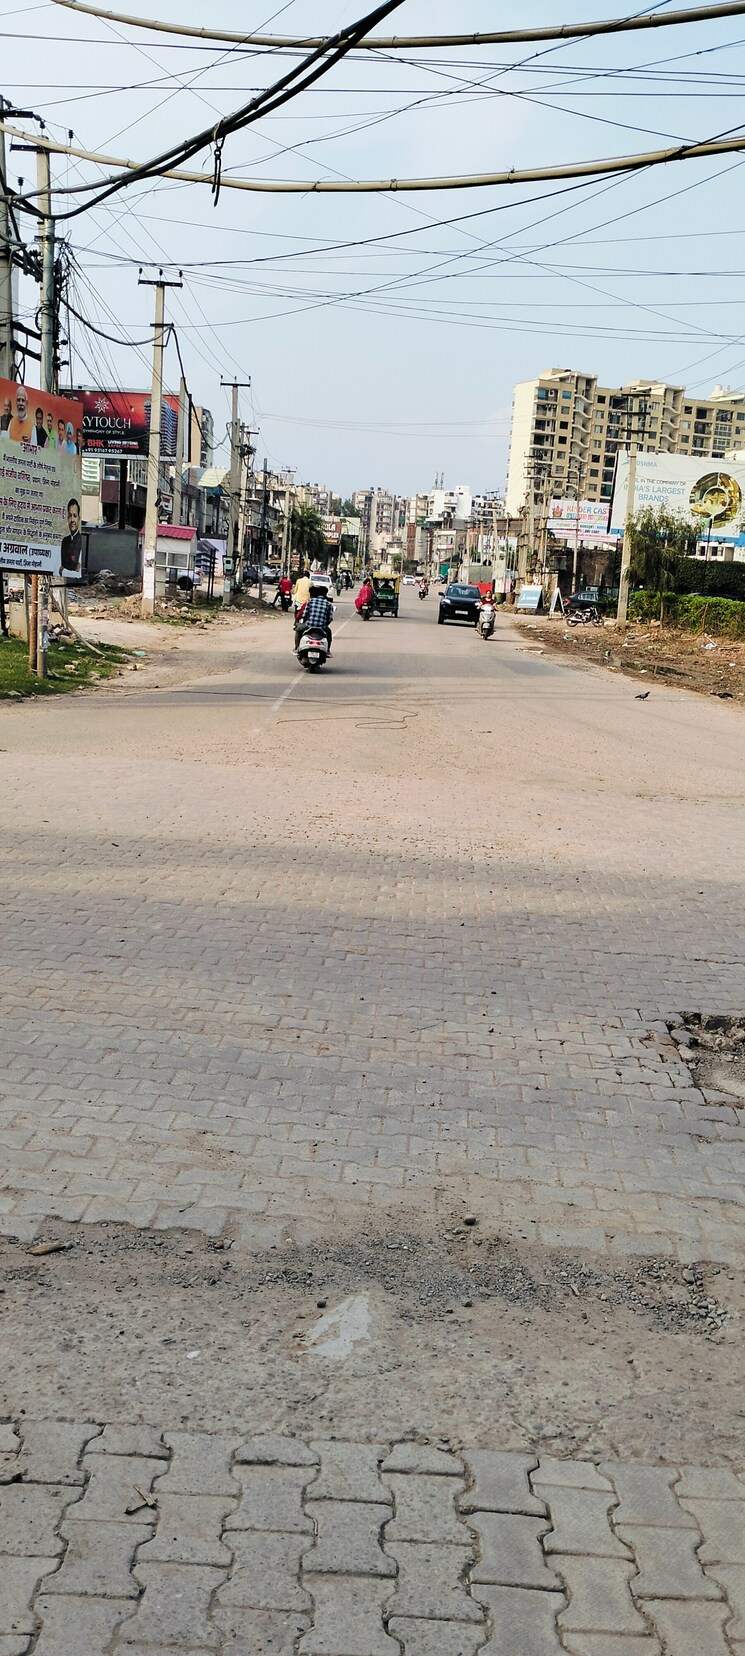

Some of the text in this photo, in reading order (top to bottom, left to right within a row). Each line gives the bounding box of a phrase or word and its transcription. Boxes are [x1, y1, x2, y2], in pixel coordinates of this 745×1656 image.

[82, 416, 131, 429] KYTOUCH
[87, 439, 104, 448] BHK
[652, 486, 686, 496] LARGEST
[638, 493, 669, 503] BRANDS
[3, 543, 28, 555] अग्रवाल
